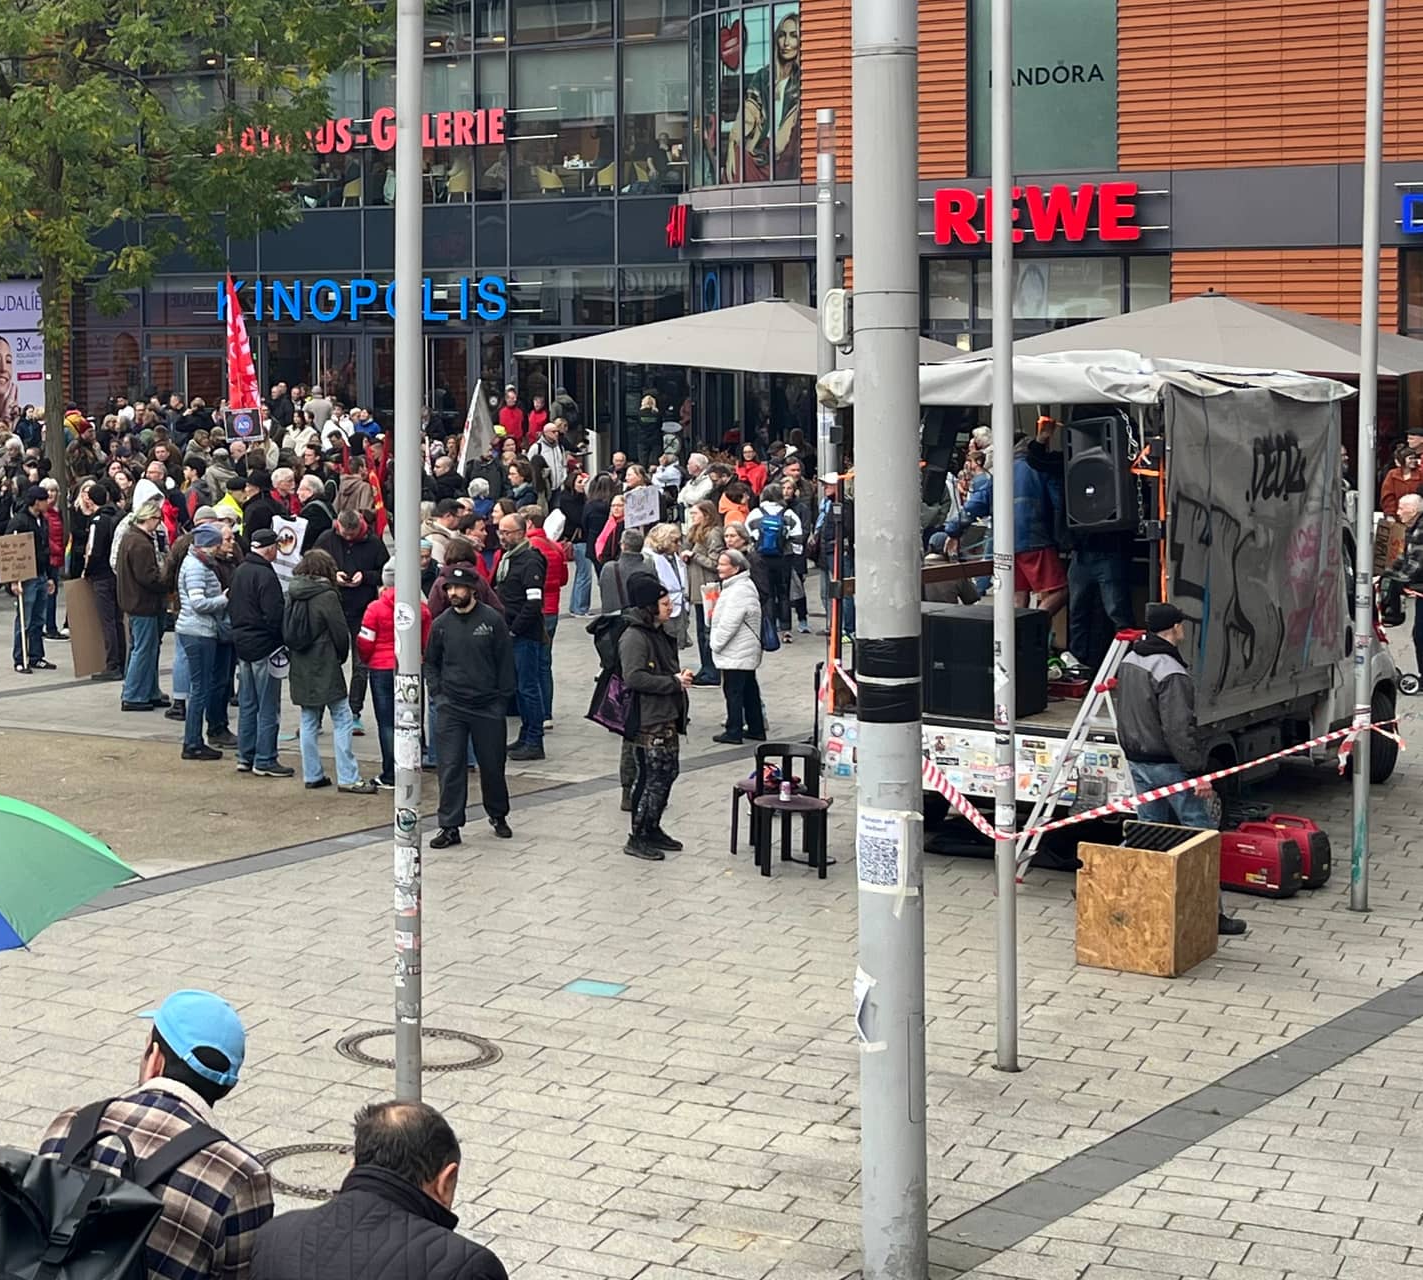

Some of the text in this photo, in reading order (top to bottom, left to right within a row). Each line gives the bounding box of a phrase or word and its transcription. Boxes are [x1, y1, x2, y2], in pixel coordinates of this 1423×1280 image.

[988, 64, 1105, 88] NDORA
[933, 182, 1141, 245] REWE
[16, 337, 32, 352] 3X
